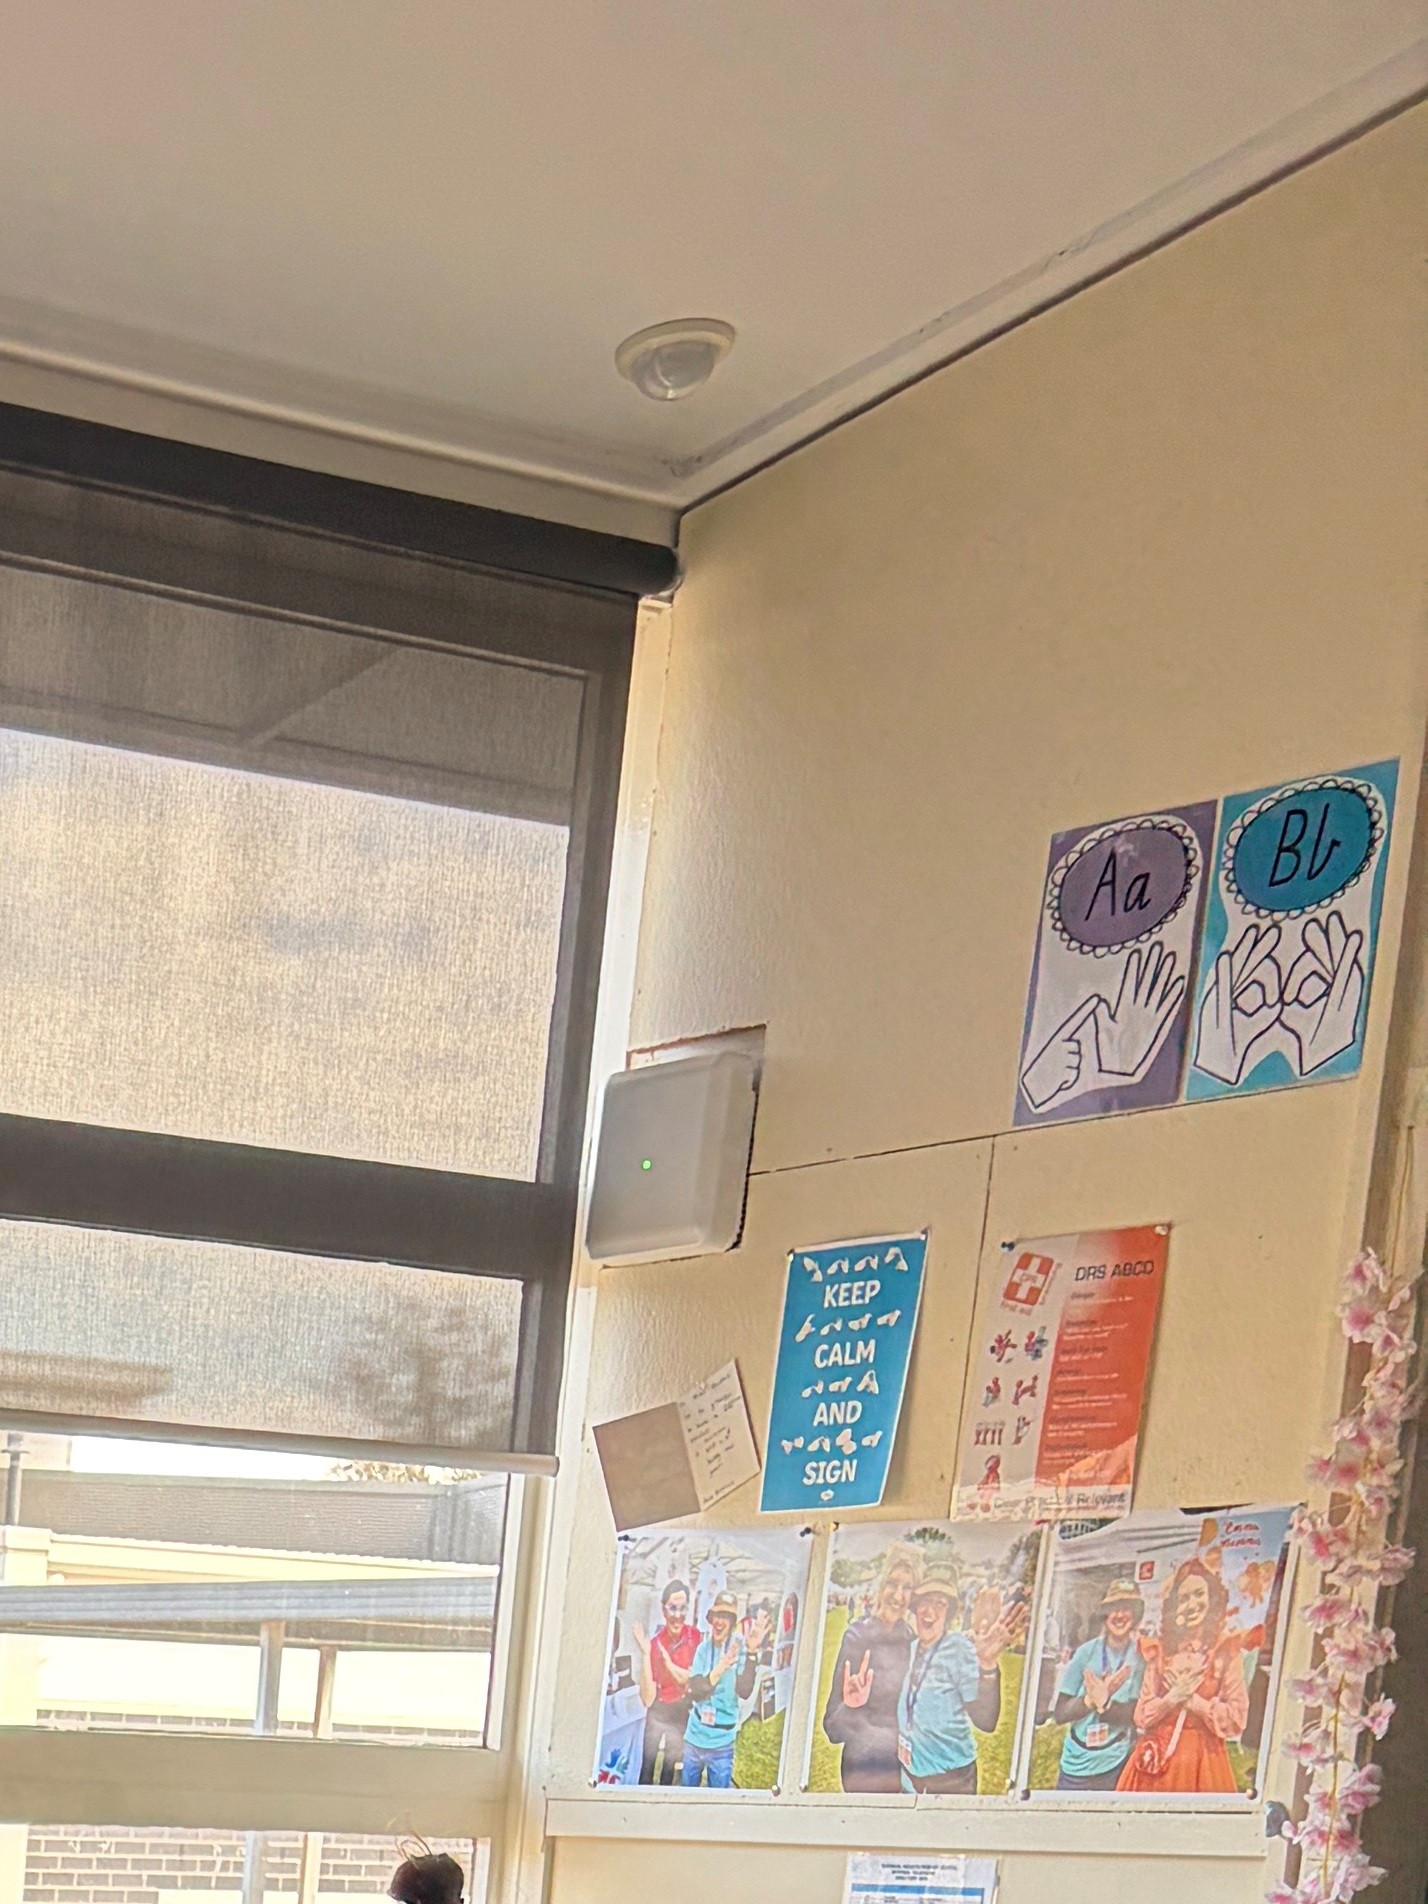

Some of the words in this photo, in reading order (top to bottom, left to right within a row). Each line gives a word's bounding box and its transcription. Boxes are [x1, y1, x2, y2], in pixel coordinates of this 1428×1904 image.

[1084, 847, 1152, 921] Aa
[1074, 1264, 1107, 1281] DRS
[1111, 1260, 1155, 1278] ABCD
[823, 1279, 882, 1308] KEEP
[814, 1338, 876, 1368] CALM
[812, 1400, 863, 1427] AND
[802, 1459, 858, 1486] SIGN
